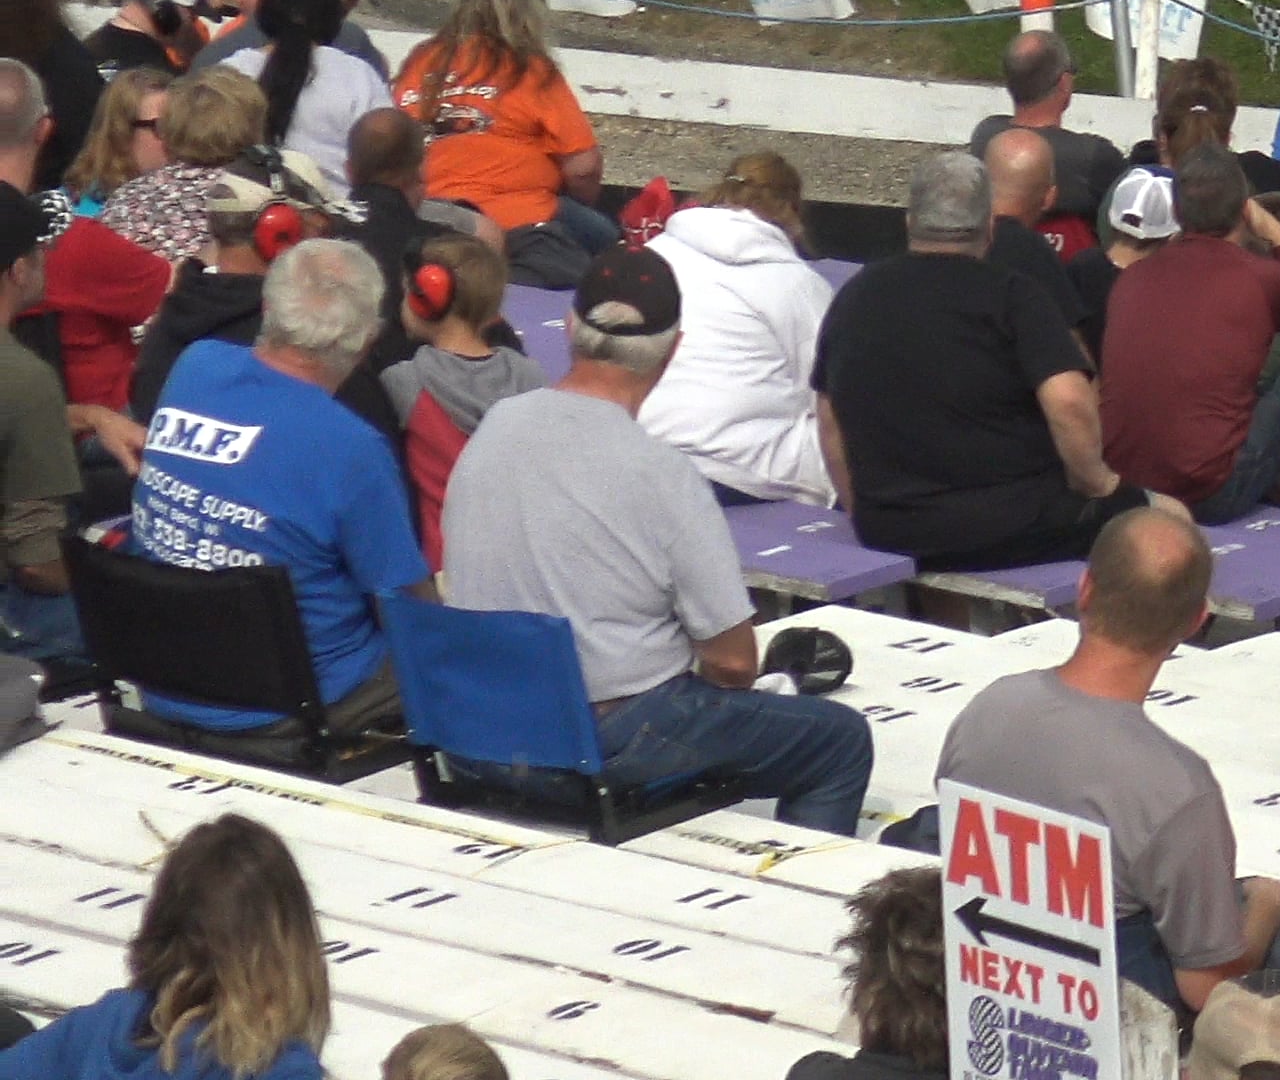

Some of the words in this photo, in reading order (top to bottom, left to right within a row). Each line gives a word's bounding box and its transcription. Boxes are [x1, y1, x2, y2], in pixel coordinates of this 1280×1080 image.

[147, 413, 241, 461] P.M.F.
[946, 797, 1106, 930] ATM
[74, 886, 145, 910] 11
[675, 887, 752, 910] 11
[612, 938, 692, 962] 10
[959, 944, 1046, 1005] NEXT
[1057, 972, 1099, 1022] TO
